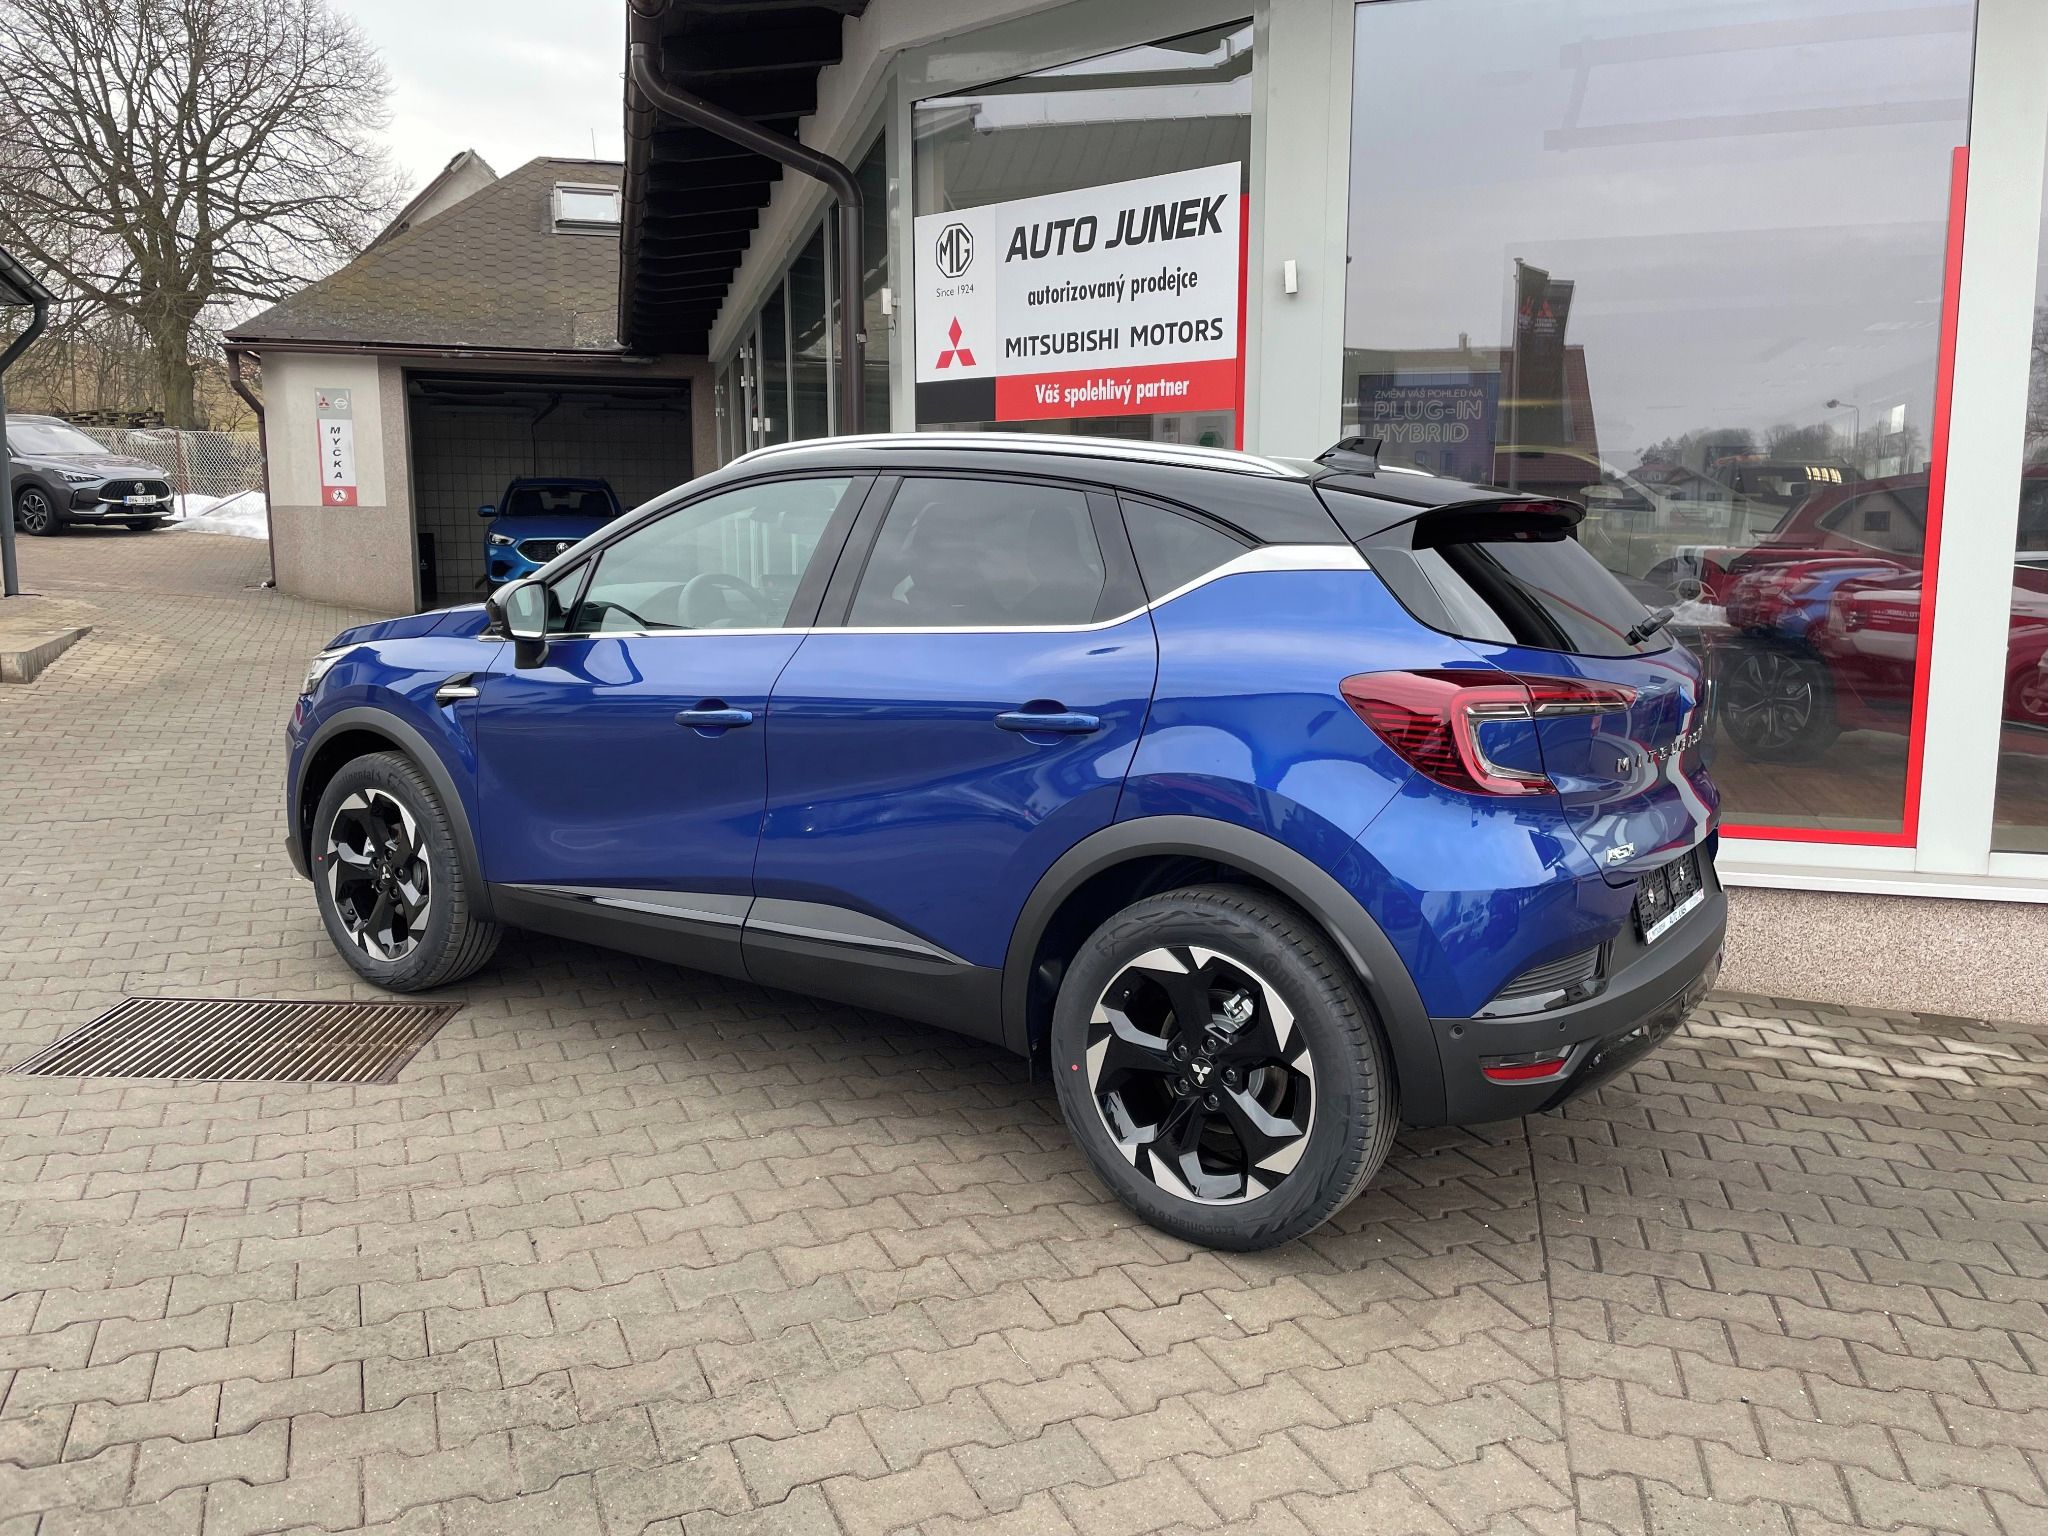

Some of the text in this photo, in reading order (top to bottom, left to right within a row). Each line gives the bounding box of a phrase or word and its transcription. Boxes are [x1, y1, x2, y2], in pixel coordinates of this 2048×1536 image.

[1005, 194, 1228, 263] AUTO JUNEK
[938, 226, 971, 275] MG
[936, 283, 974, 298] Since 1924
[1028, 266, 1198, 306] autorizovaný prodejce
[1005, 317, 1223, 358] MITSUBISHI MOTORS
[1035, 378, 1190, 408] Váš spolehlivý partner
[1428, 389, 1467, 398] POHLED
[1468, 388, 1483, 398] NA
[1374, 400, 1482, 420] PLUG-IN
[1373, 423, 1469, 443] HYBRID
